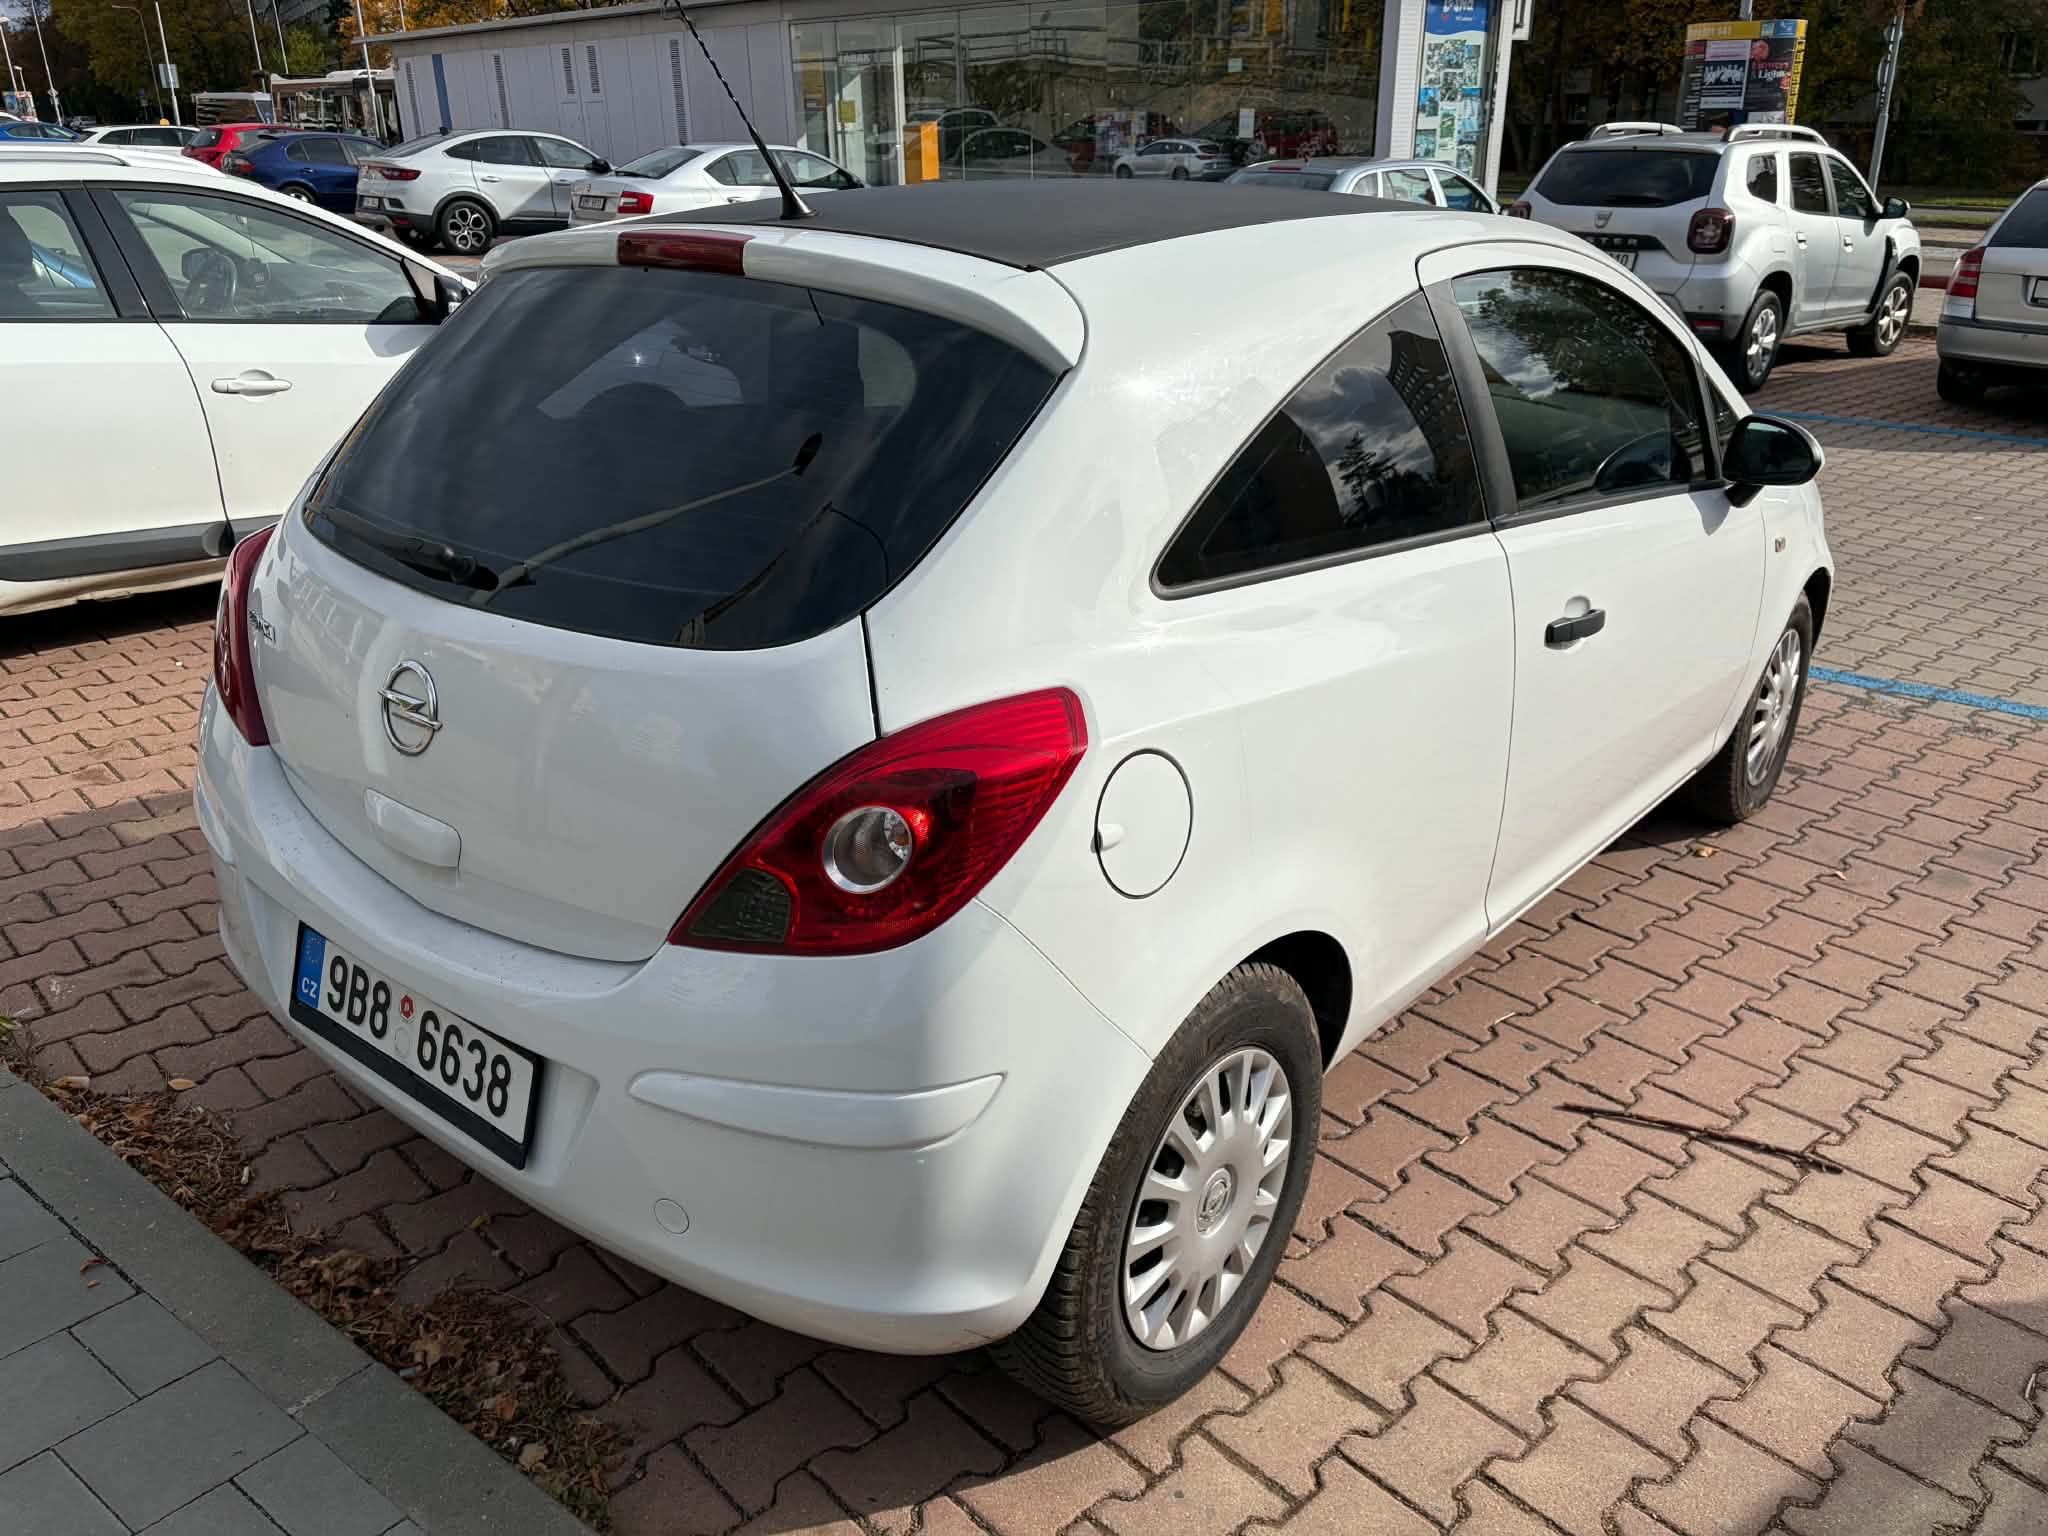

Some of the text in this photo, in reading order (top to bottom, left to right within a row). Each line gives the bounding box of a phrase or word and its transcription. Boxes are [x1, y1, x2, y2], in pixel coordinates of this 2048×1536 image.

[301, 976, 318, 999] CZ
[327, 955, 512, 1117] 9B8 6638
